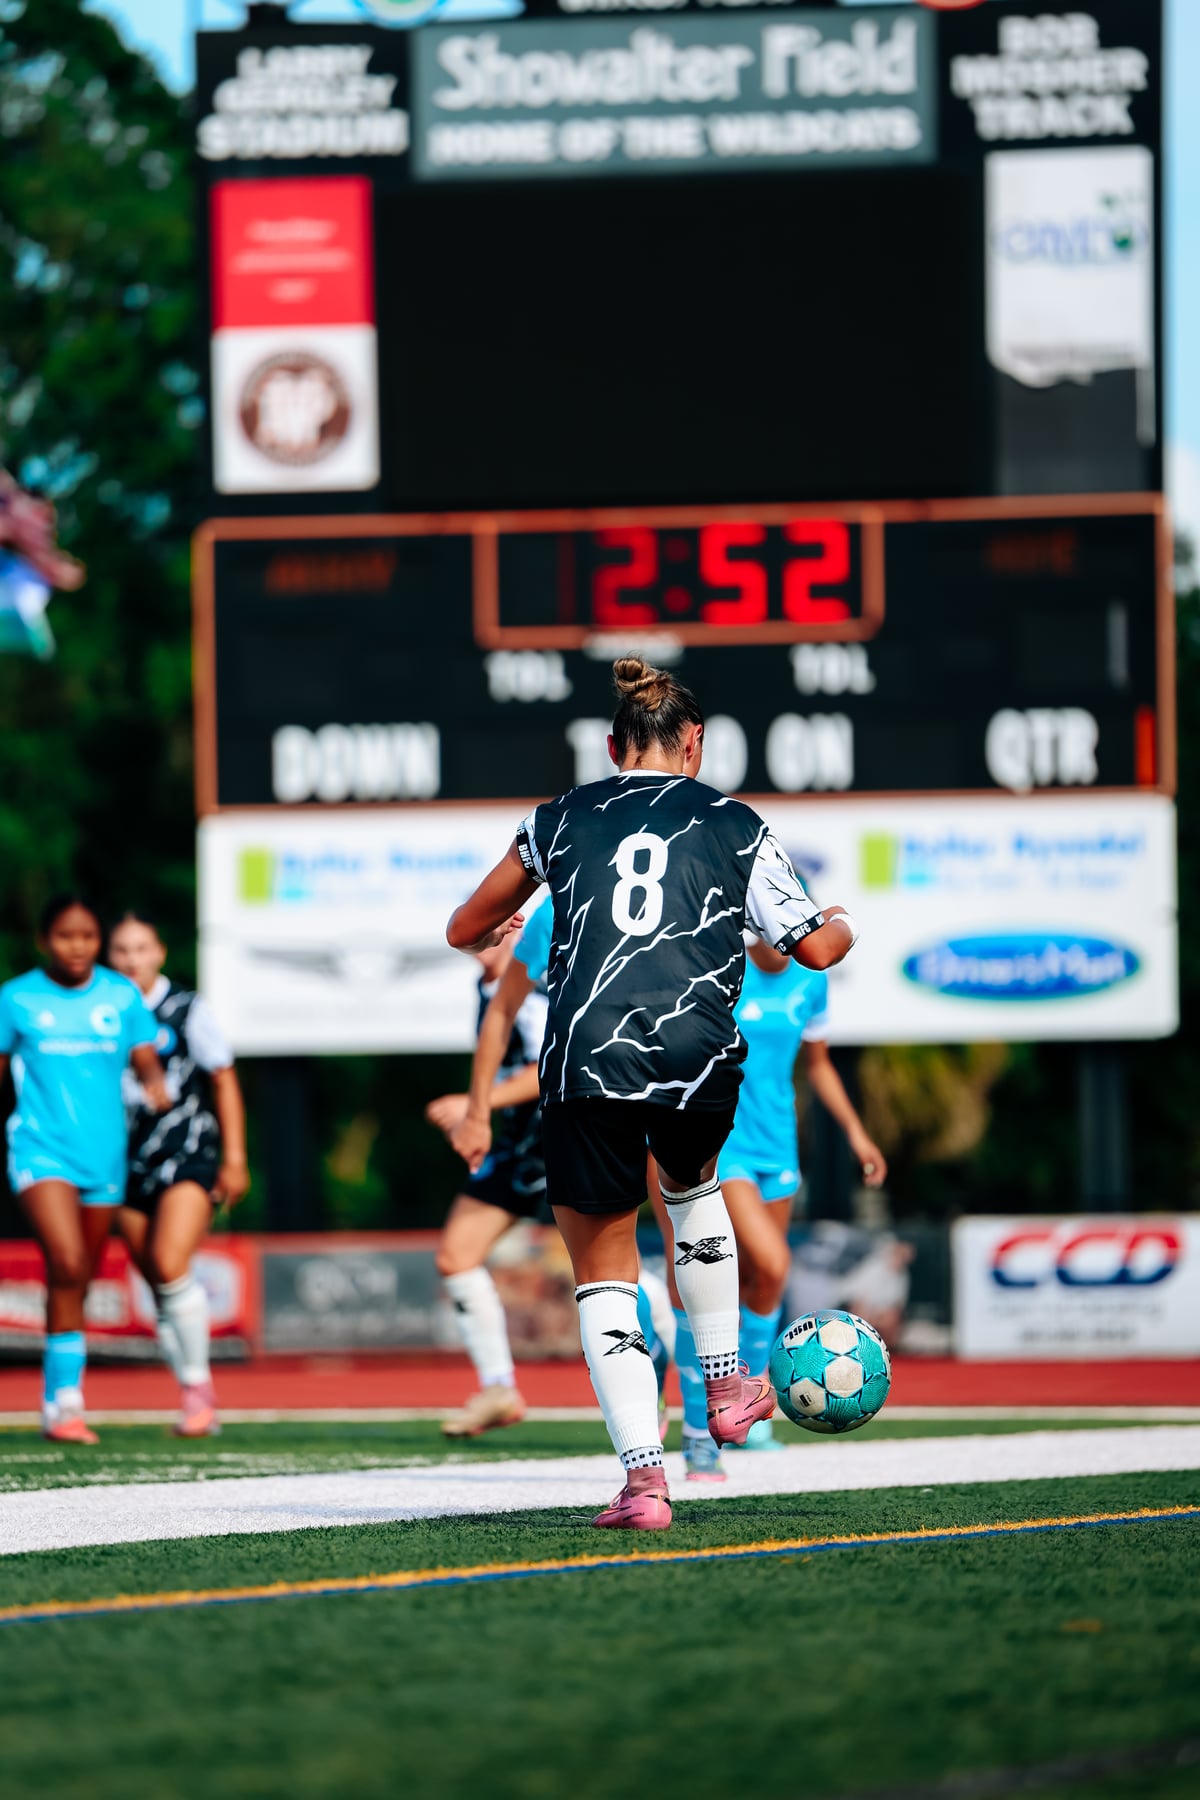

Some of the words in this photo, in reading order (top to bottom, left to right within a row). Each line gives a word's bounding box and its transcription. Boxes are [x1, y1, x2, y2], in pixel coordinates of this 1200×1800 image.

[434, 28, 754, 108] Showalter
[427, 123, 554, 164] HOME
[559, 120, 618, 161] OF
[624, 117, 705, 158] THE
[708, 108, 921, 156] WILDCATS
[593, 517, 851, 628] 2:52
[272, 723, 441, 801] DOWN
[765, 712, 854, 793] ON
[985, 707, 1099, 794] QTR
[518, 843, 534, 869] BHFC
[611, 832, 669, 937] 8
[790, 922, 812, 941] BHFC
